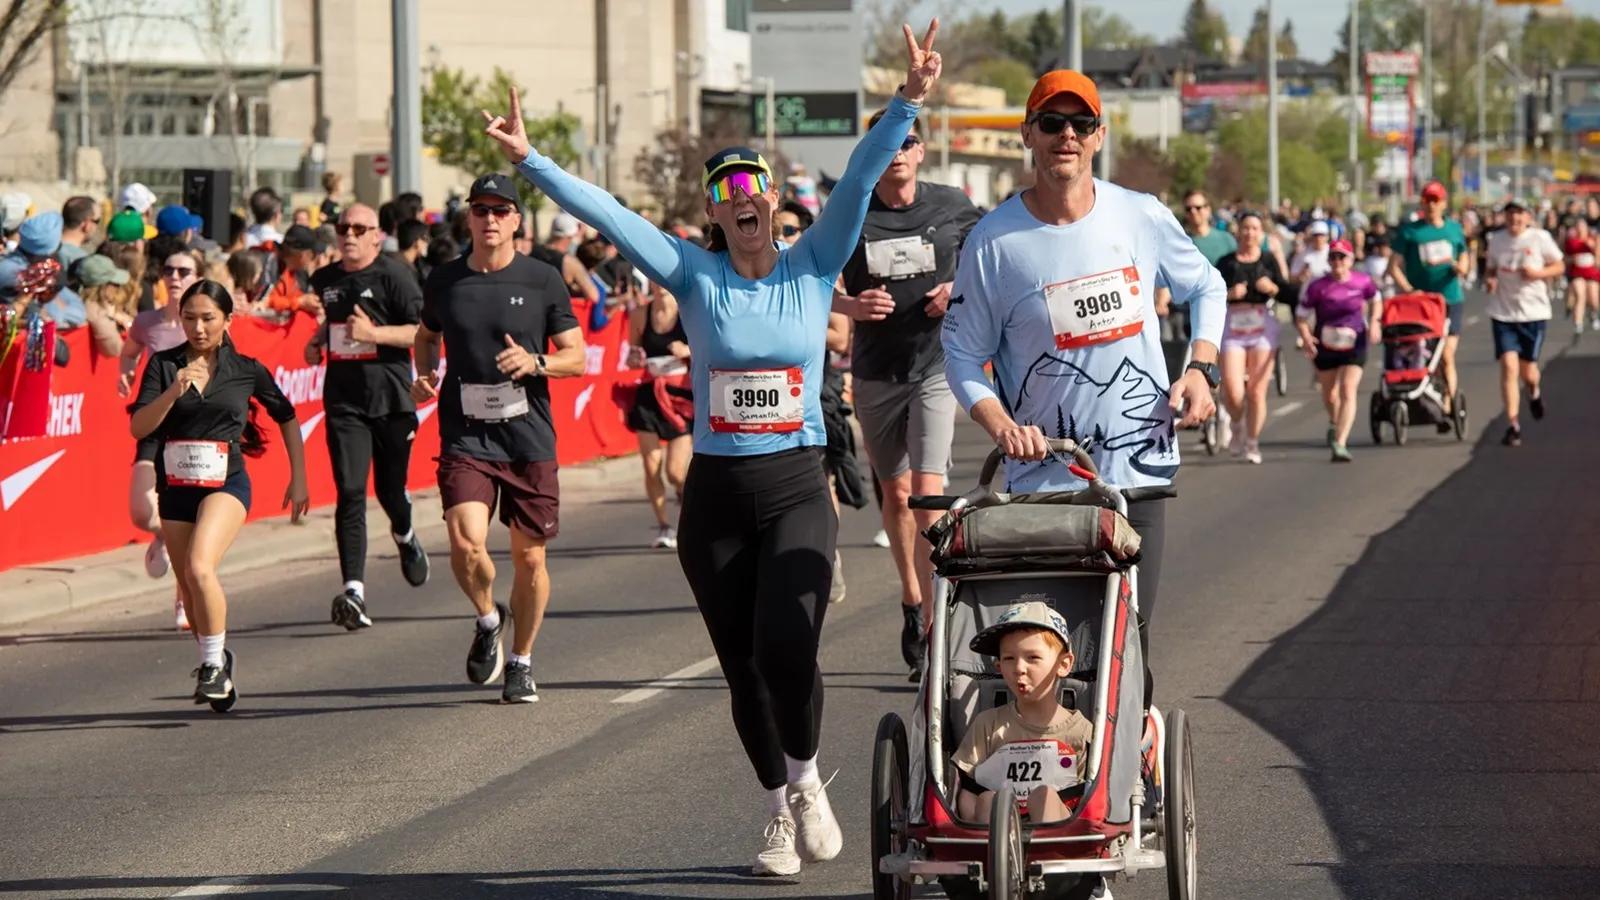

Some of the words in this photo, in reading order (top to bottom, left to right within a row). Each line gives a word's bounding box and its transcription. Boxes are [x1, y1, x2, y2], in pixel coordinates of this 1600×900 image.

[1074, 290, 1122, 319] 3989
[733, 389, 779, 407] 3990
[739, 411, 780, 421] Samantha
[177, 461, 211, 470] Cadence
[1006, 761, 1042, 783] 422
